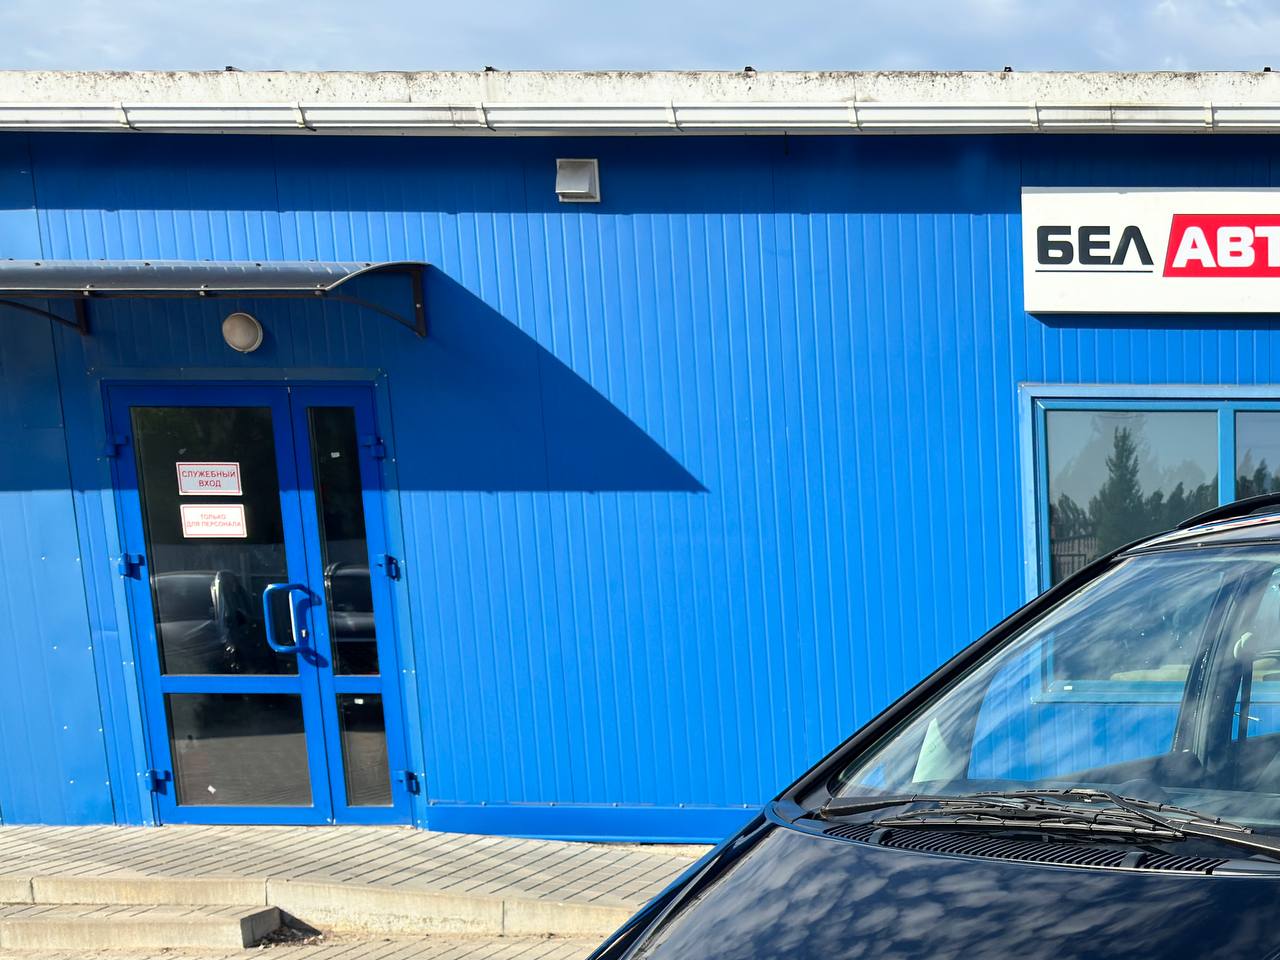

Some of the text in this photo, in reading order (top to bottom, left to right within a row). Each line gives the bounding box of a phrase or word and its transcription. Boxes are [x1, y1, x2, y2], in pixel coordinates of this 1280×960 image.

[1035, 225, 1153, 266] БЕЛ
[181, 469, 236, 478] СЛУЖЕБНЫЙ
[198, 480, 222, 488] ВХОД
